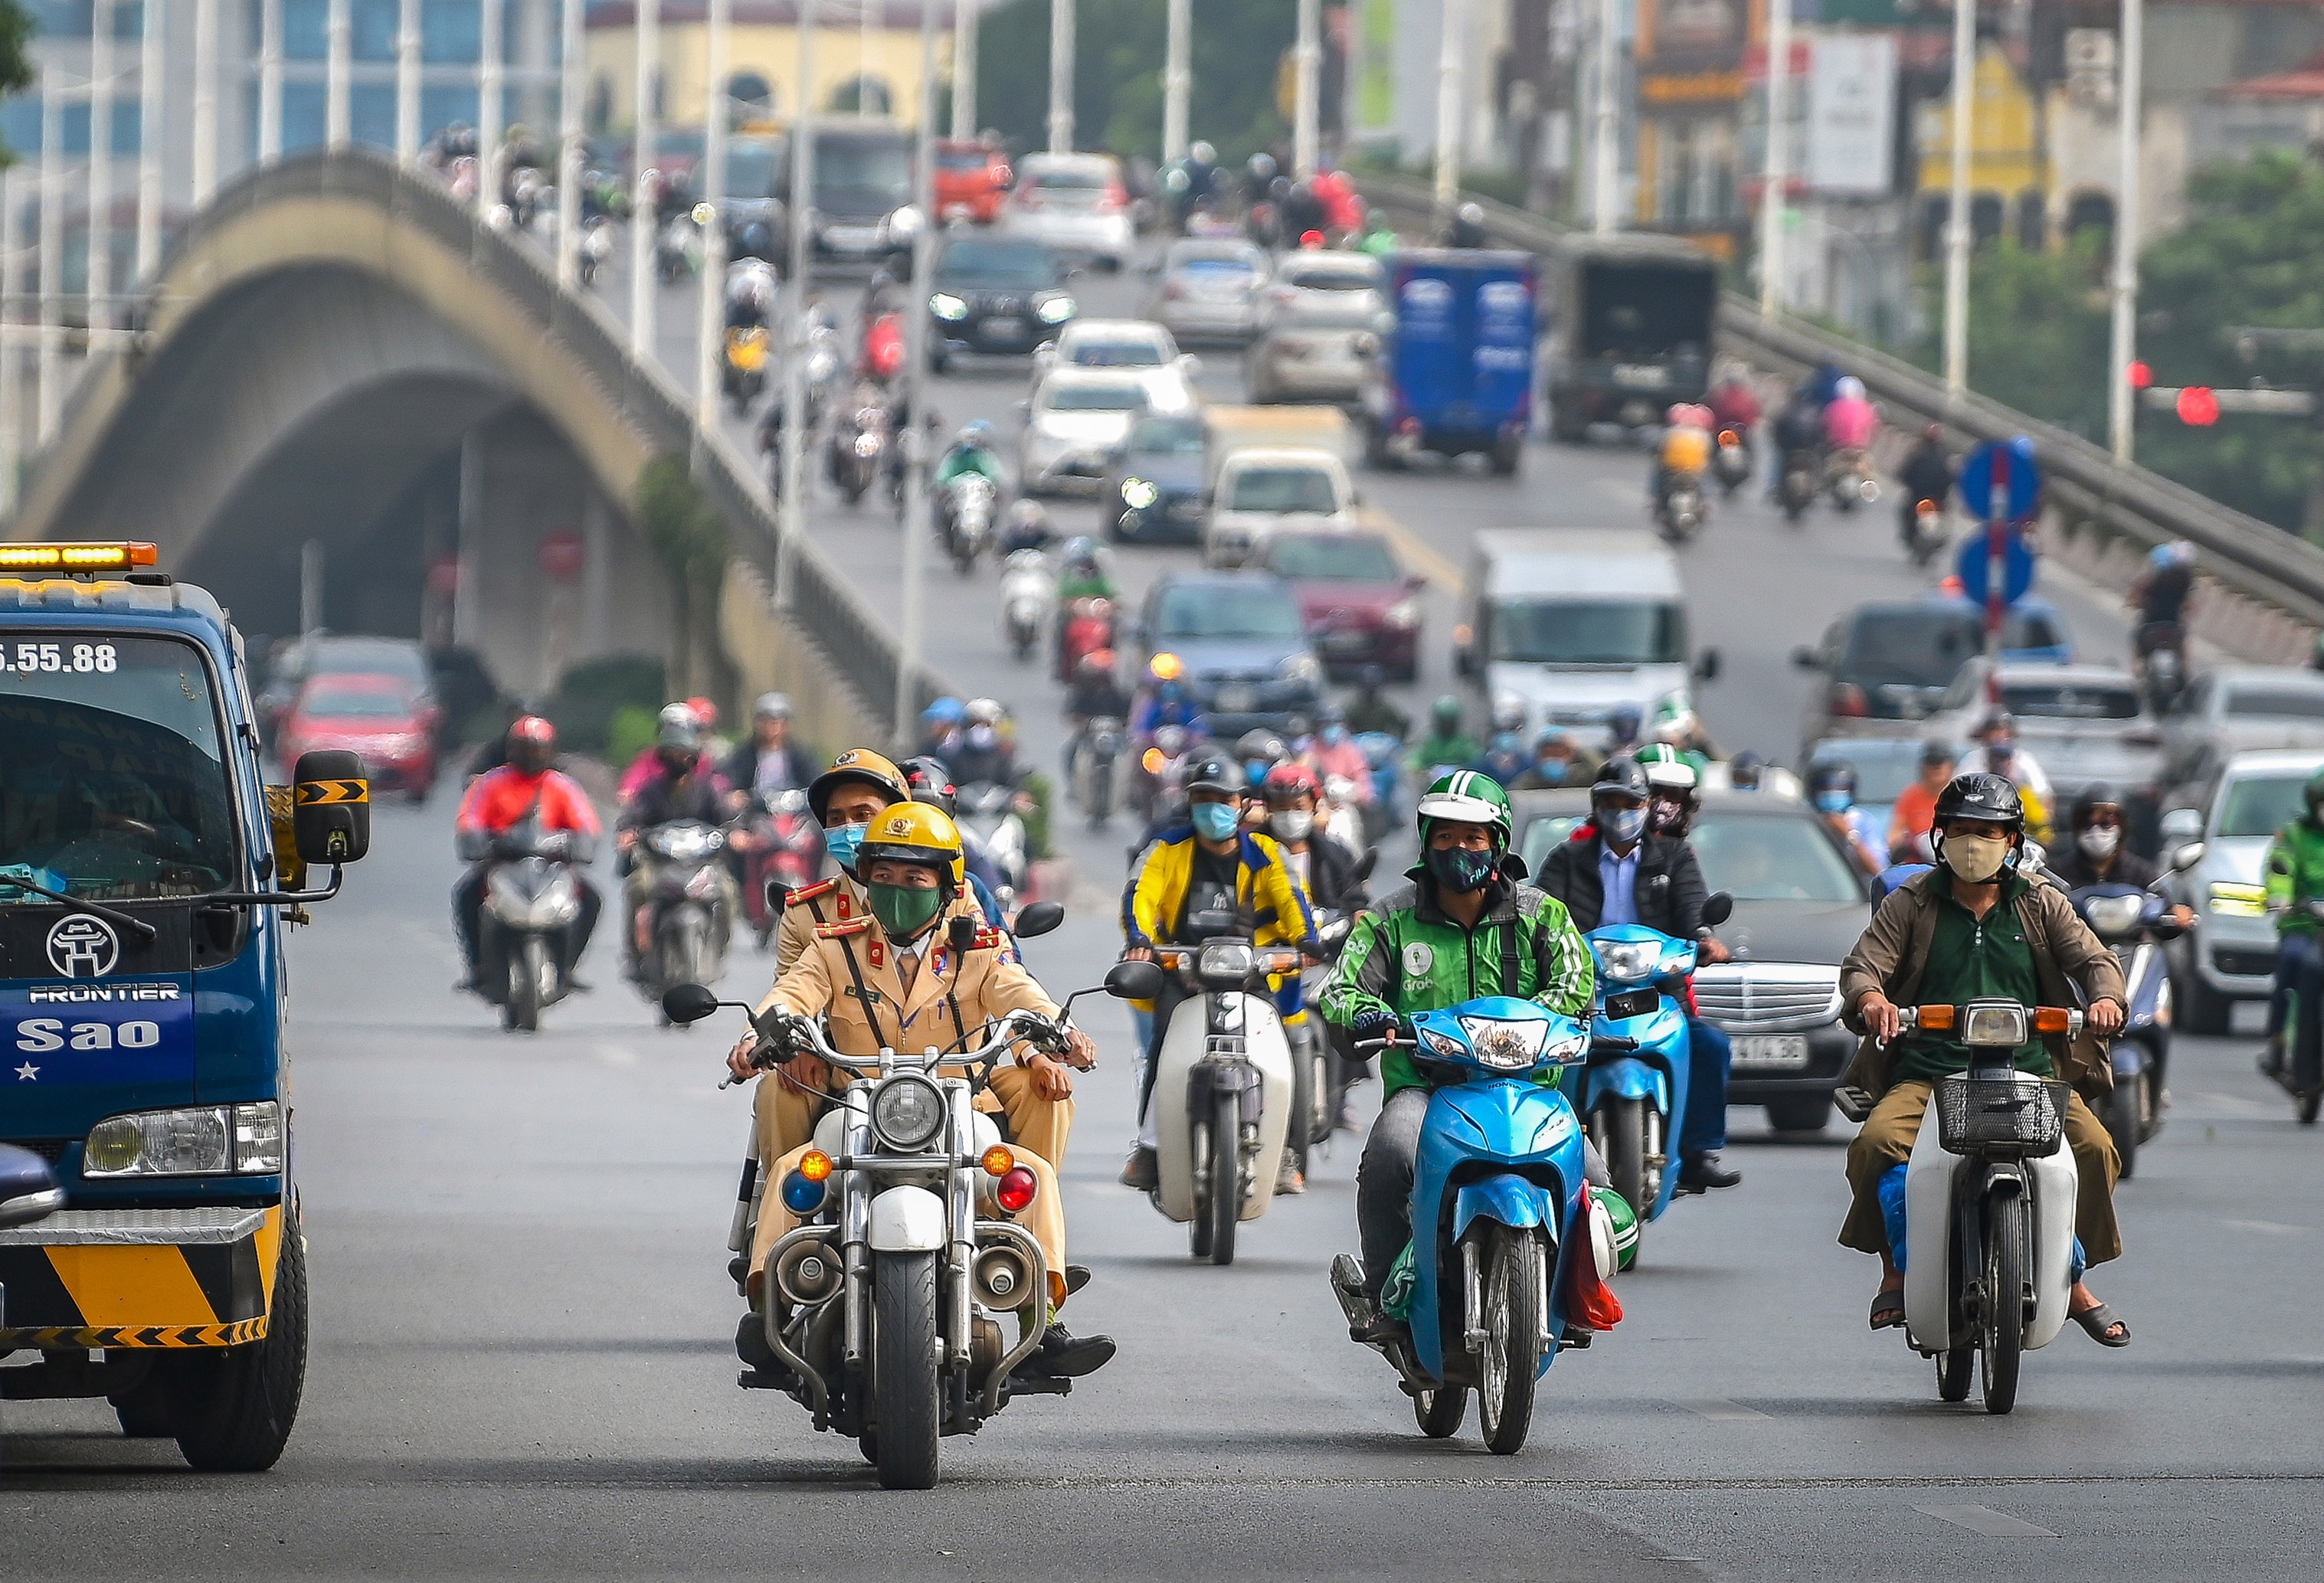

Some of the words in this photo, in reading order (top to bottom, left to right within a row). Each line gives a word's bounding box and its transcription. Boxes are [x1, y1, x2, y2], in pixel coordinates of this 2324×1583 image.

[0, 643, 117, 673] .55.88
[1469, 864, 1489, 884] FILA
[29, 983, 180, 1003] FRONTIER
[1402, 976, 1434, 992] Grab
[16, 1019, 159, 1052] Sao
[1488, 1081, 1522, 1091] HONDA
